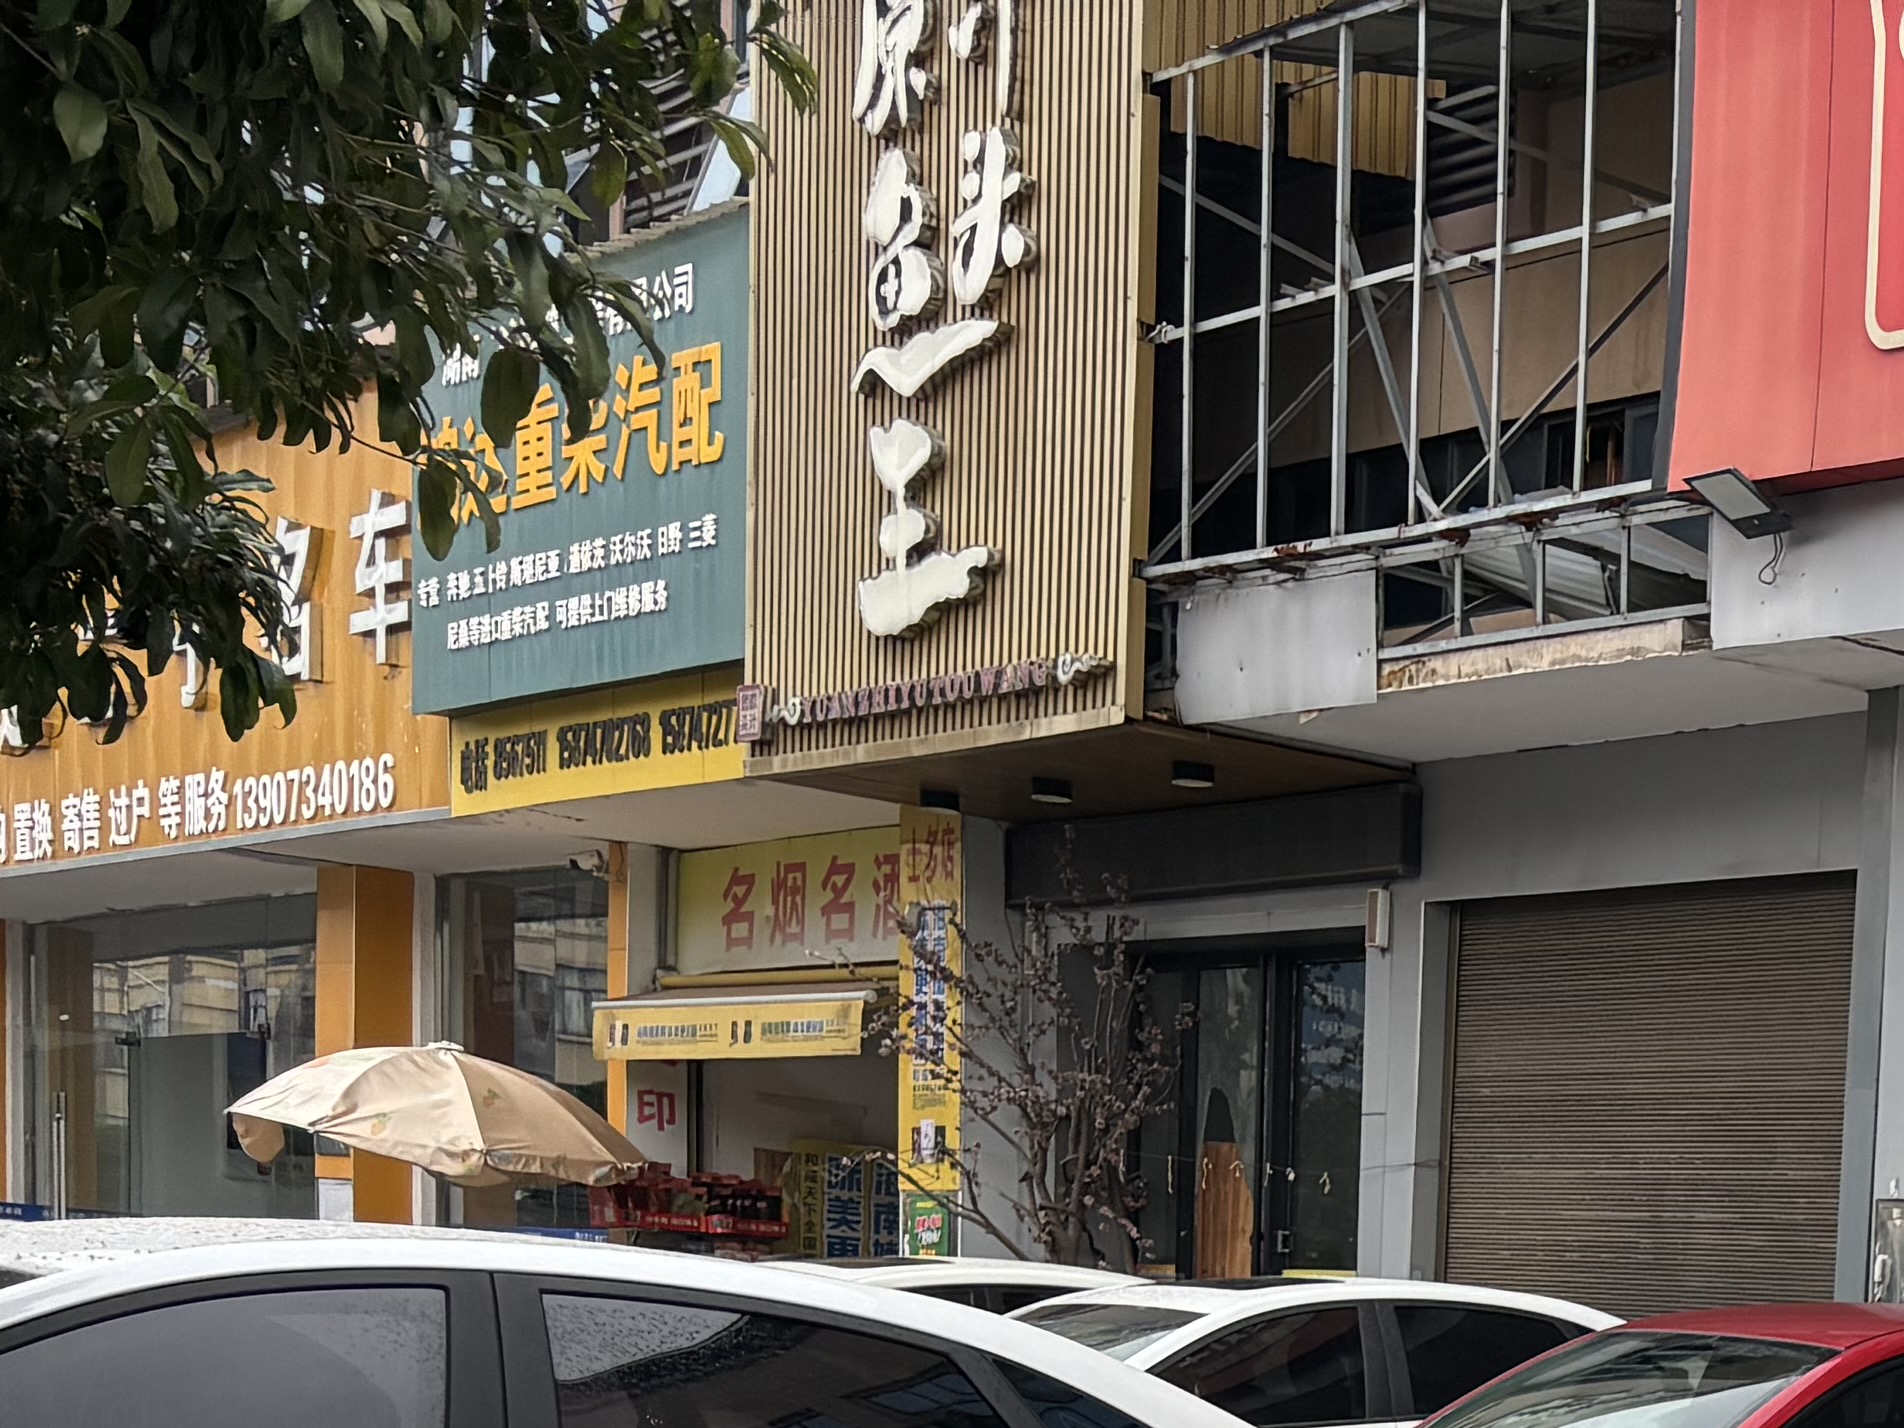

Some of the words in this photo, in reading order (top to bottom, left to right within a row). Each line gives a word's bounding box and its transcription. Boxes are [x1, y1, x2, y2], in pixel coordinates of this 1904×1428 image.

[609, 528, 652, 564] 沃尔沃
[657, 521, 683, 556] 日野
[687, 513, 718, 549] 三菱
[13, 801, 54, 862] 置换
[61, 787, 101, 855] 寄售
[108, 778, 151, 848] 过户
[233, 752, 395, 830] 13907340186
